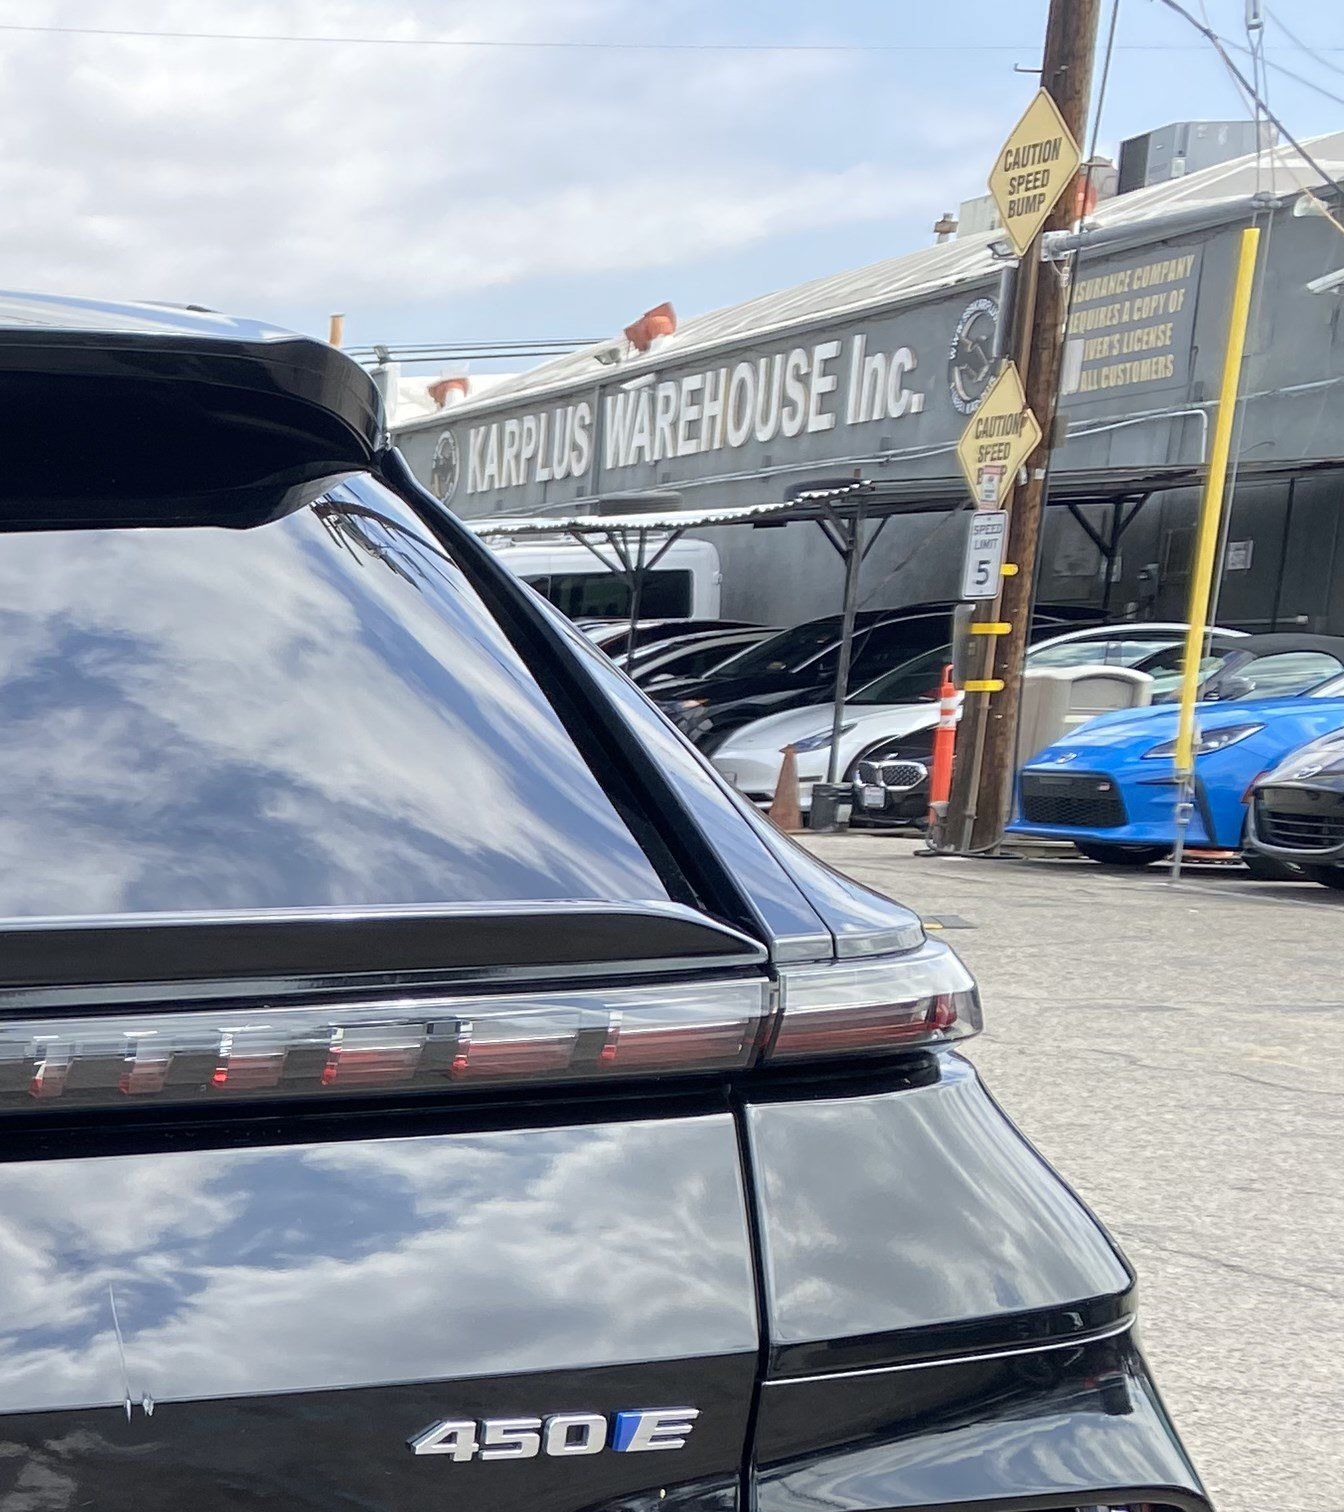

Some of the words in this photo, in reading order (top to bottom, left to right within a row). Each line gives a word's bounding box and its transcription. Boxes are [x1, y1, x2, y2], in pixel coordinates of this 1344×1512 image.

[1004, 137, 1062, 172] CAUTION
[1008, 169, 1050, 196] SPEED
[1007, 193, 1046, 219] BUMP
[1072, 270, 1131, 304] SURANCE
[1133, 255, 1195, 290] COMPANY
[1122, 301, 1130, 323] A
[1133, 292, 1167, 321] COPY
[1168, 287, 1185, 314] OF
[1122, 322, 1173, 354] LICENSE
[1100, 354, 1174, 389] CUSTOMERS
[467, 401, 594, 494] KARPLUS
[605, 340, 843, 470] WAREHOUSE
[846, 334, 925, 426] Inc.
[975, 412, 1022, 440] CAUTION
[978, 442, 1010, 463] SPEED
[976, 464, 1007, 485] BP
[973, 524, 1003, 536] SPEED
[974, 538, 999, 551] LIMIT
[975, 560, 992, 586] 5
